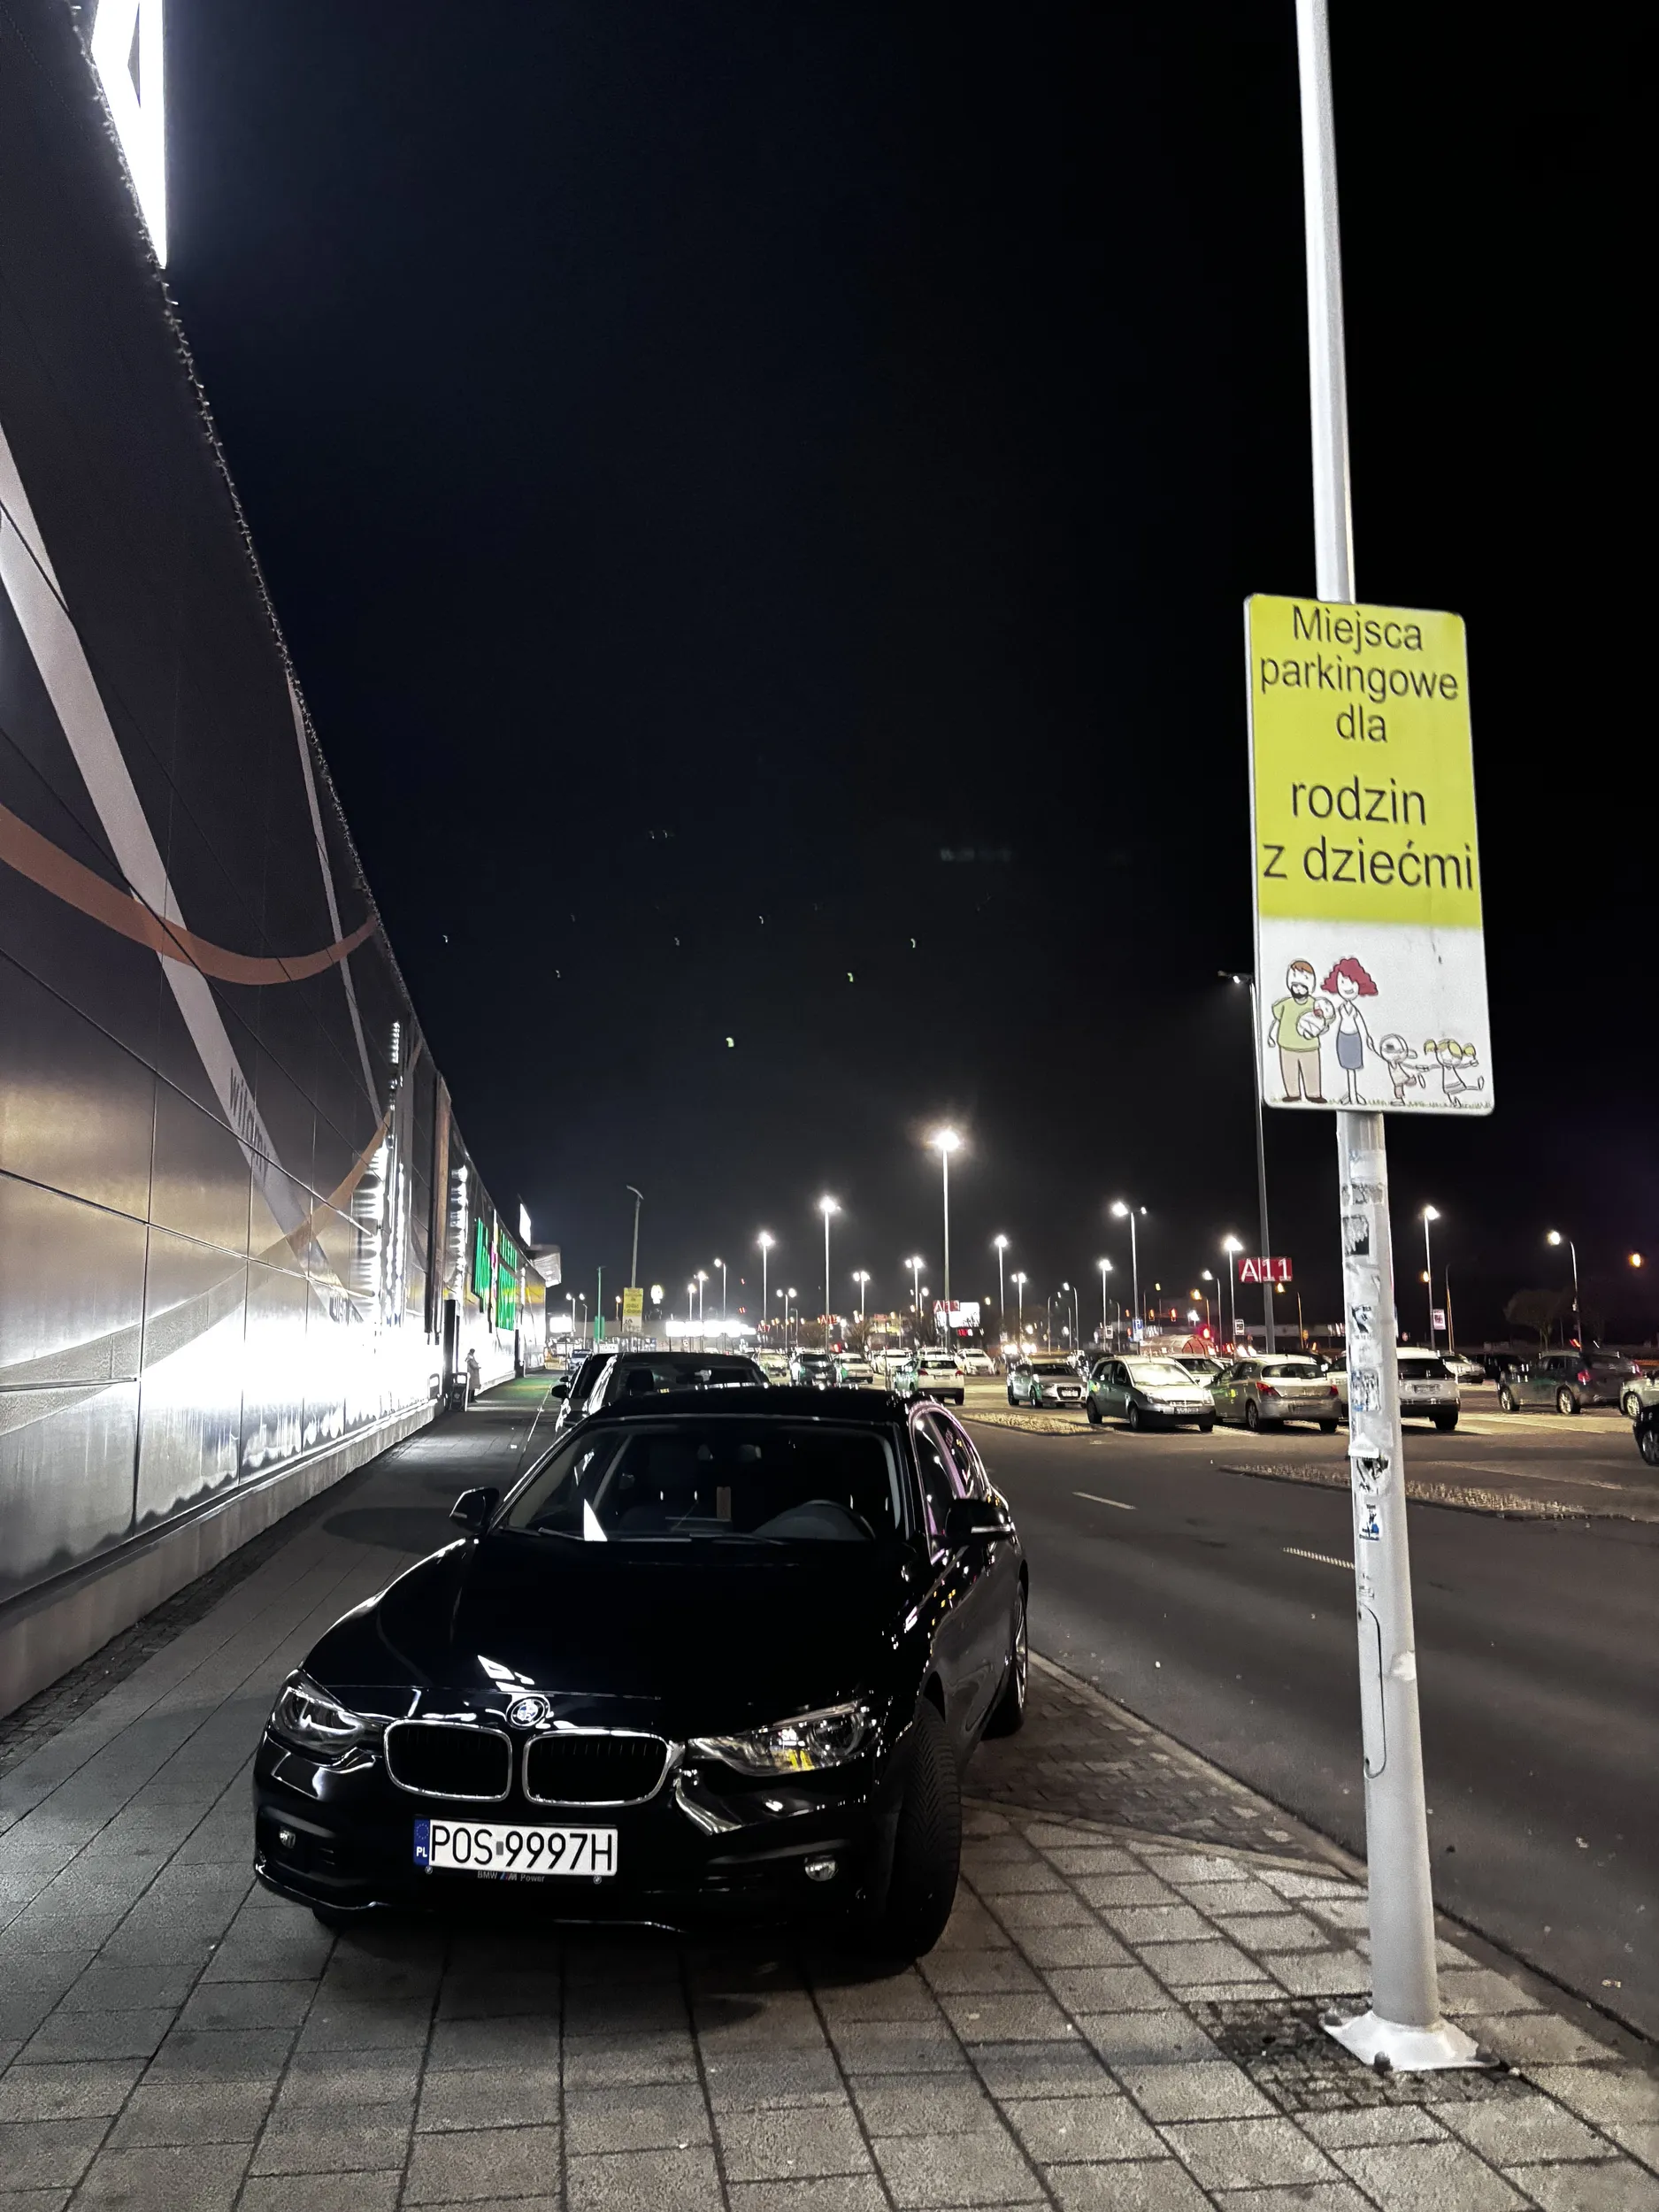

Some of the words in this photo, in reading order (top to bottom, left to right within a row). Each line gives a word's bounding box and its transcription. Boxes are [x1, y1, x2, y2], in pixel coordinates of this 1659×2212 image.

[1292, 603, 1424, 655] Miejsca
[1260, 652, 1459, 704] parkingowe
[1336, 703, 1387, 743] dla
[1291, 774, 1427, 826] rodzin
[1263, 843, 1288, 880] z
[1302, 834, 1474, 892] dziećmi
[416, 1847, 428, 1858] PL
[431, 1824, 493, 1865] POS
[505, 1831, 612, 1871] 9997H
[477, 1870, 498, 1880] BMW
[520, 1874, 545, 1883] Power
